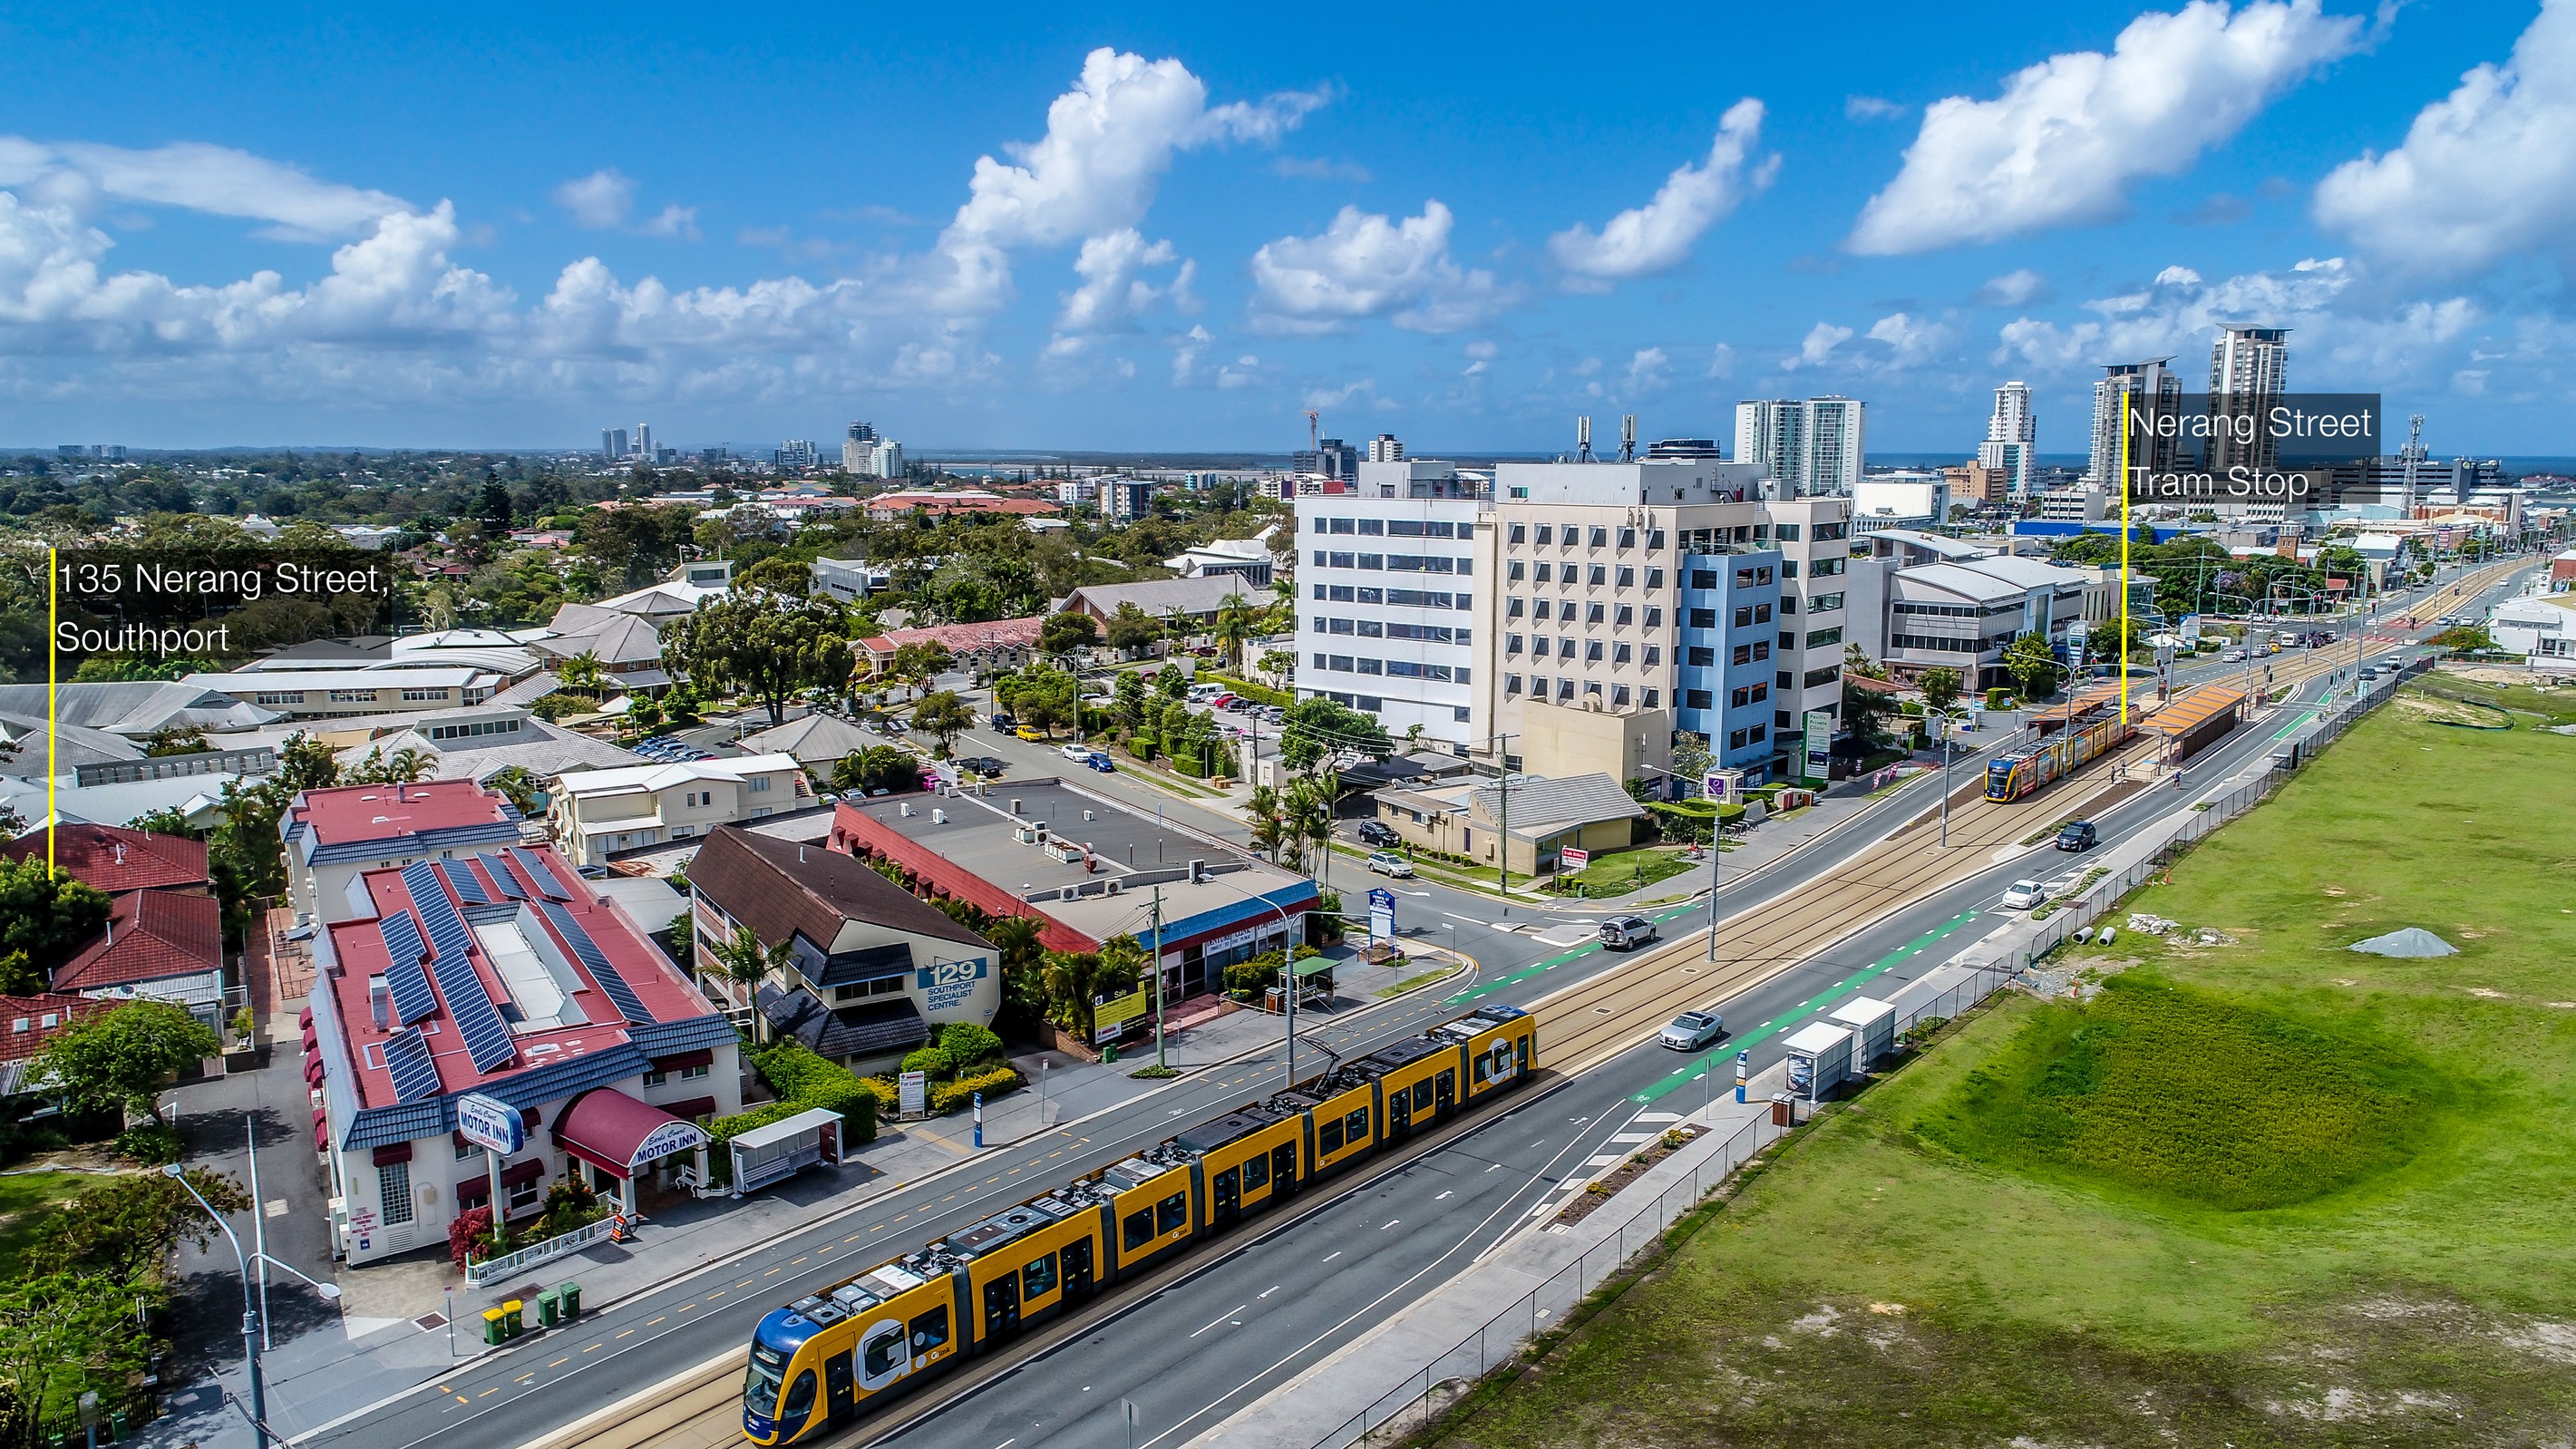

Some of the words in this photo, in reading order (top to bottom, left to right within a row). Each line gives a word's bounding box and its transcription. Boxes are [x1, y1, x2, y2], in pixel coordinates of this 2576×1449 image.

[930, 960, 977, 986] 129
[928, 981, 976, 996] SOUTHPORT
[928, 989, 972, 1004] SPECIALIST
[1114, 989, 1127, 998] Sale
[928, 999, 961, 1011] CENTRE.
[461, 1111, 491, 1137] MOTOR
[492, 1123, 510, 1144] INN
[648, 1133, 666, 1145] Earls
[667, 1127, 686, 1138] Court
[478, 1133, 501, 1150] VACANCY
[637, 1139, 677, 1162] MOTOR
[679, 1132, 697, 1148] INN
